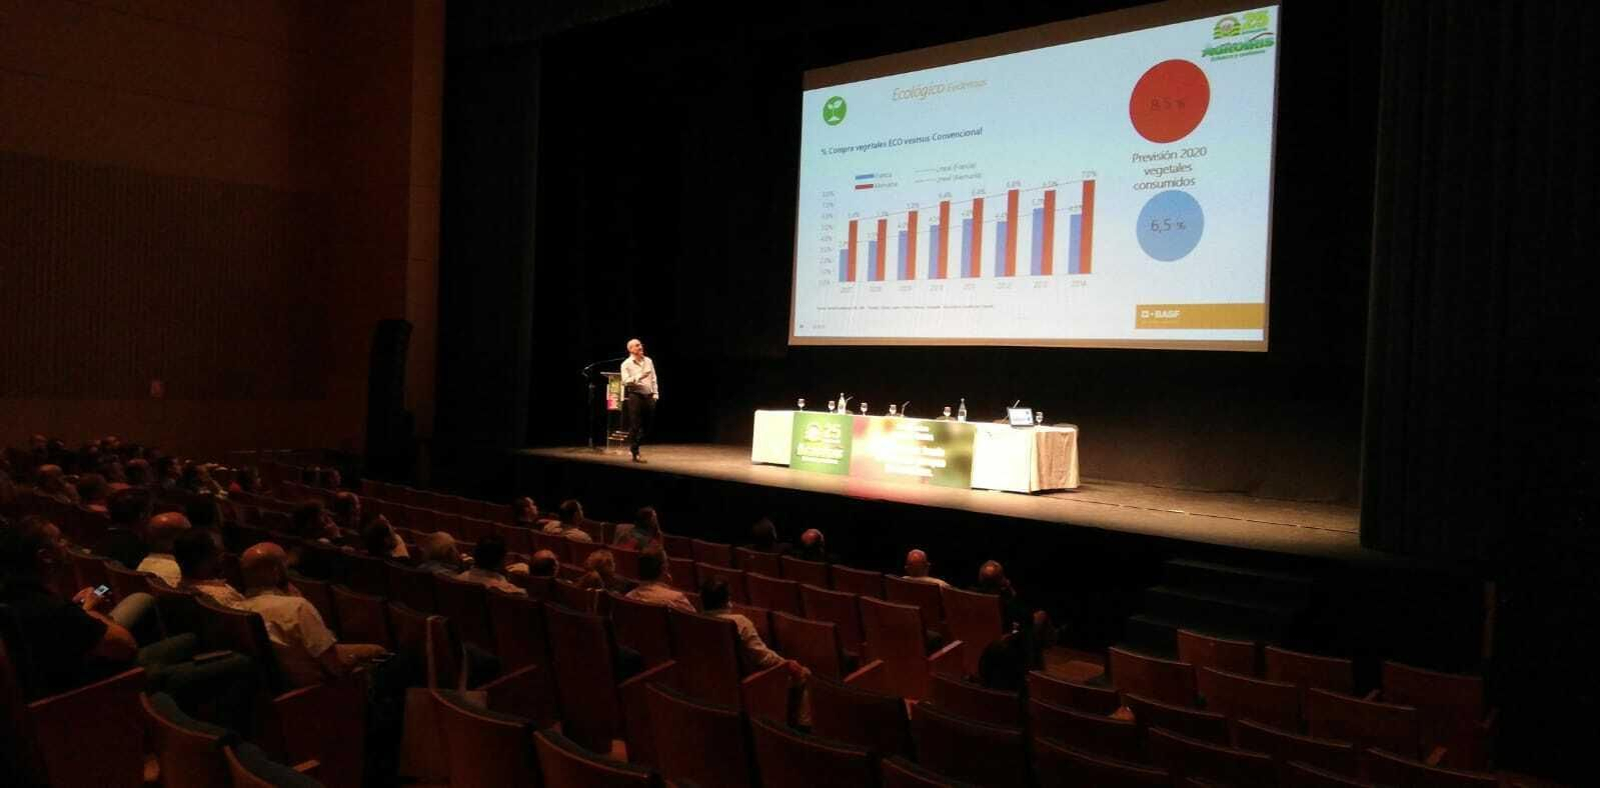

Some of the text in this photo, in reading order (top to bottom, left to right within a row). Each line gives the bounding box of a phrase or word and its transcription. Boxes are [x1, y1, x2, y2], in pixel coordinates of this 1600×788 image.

[892, 83, 945, 101] Ecológico
[888, 138, 903, 148] ECO
[932, 127, 983, 141] Convencional
[1132, 147, 1208, 163] Previsión 2020
[1144, 163, 1193, 178] vegetales
[1133, 176, 1196, 191] consumidos
[1151, 218, 1186, 233] 6,5 %
[1154, 310, 1180, 319] BASF
